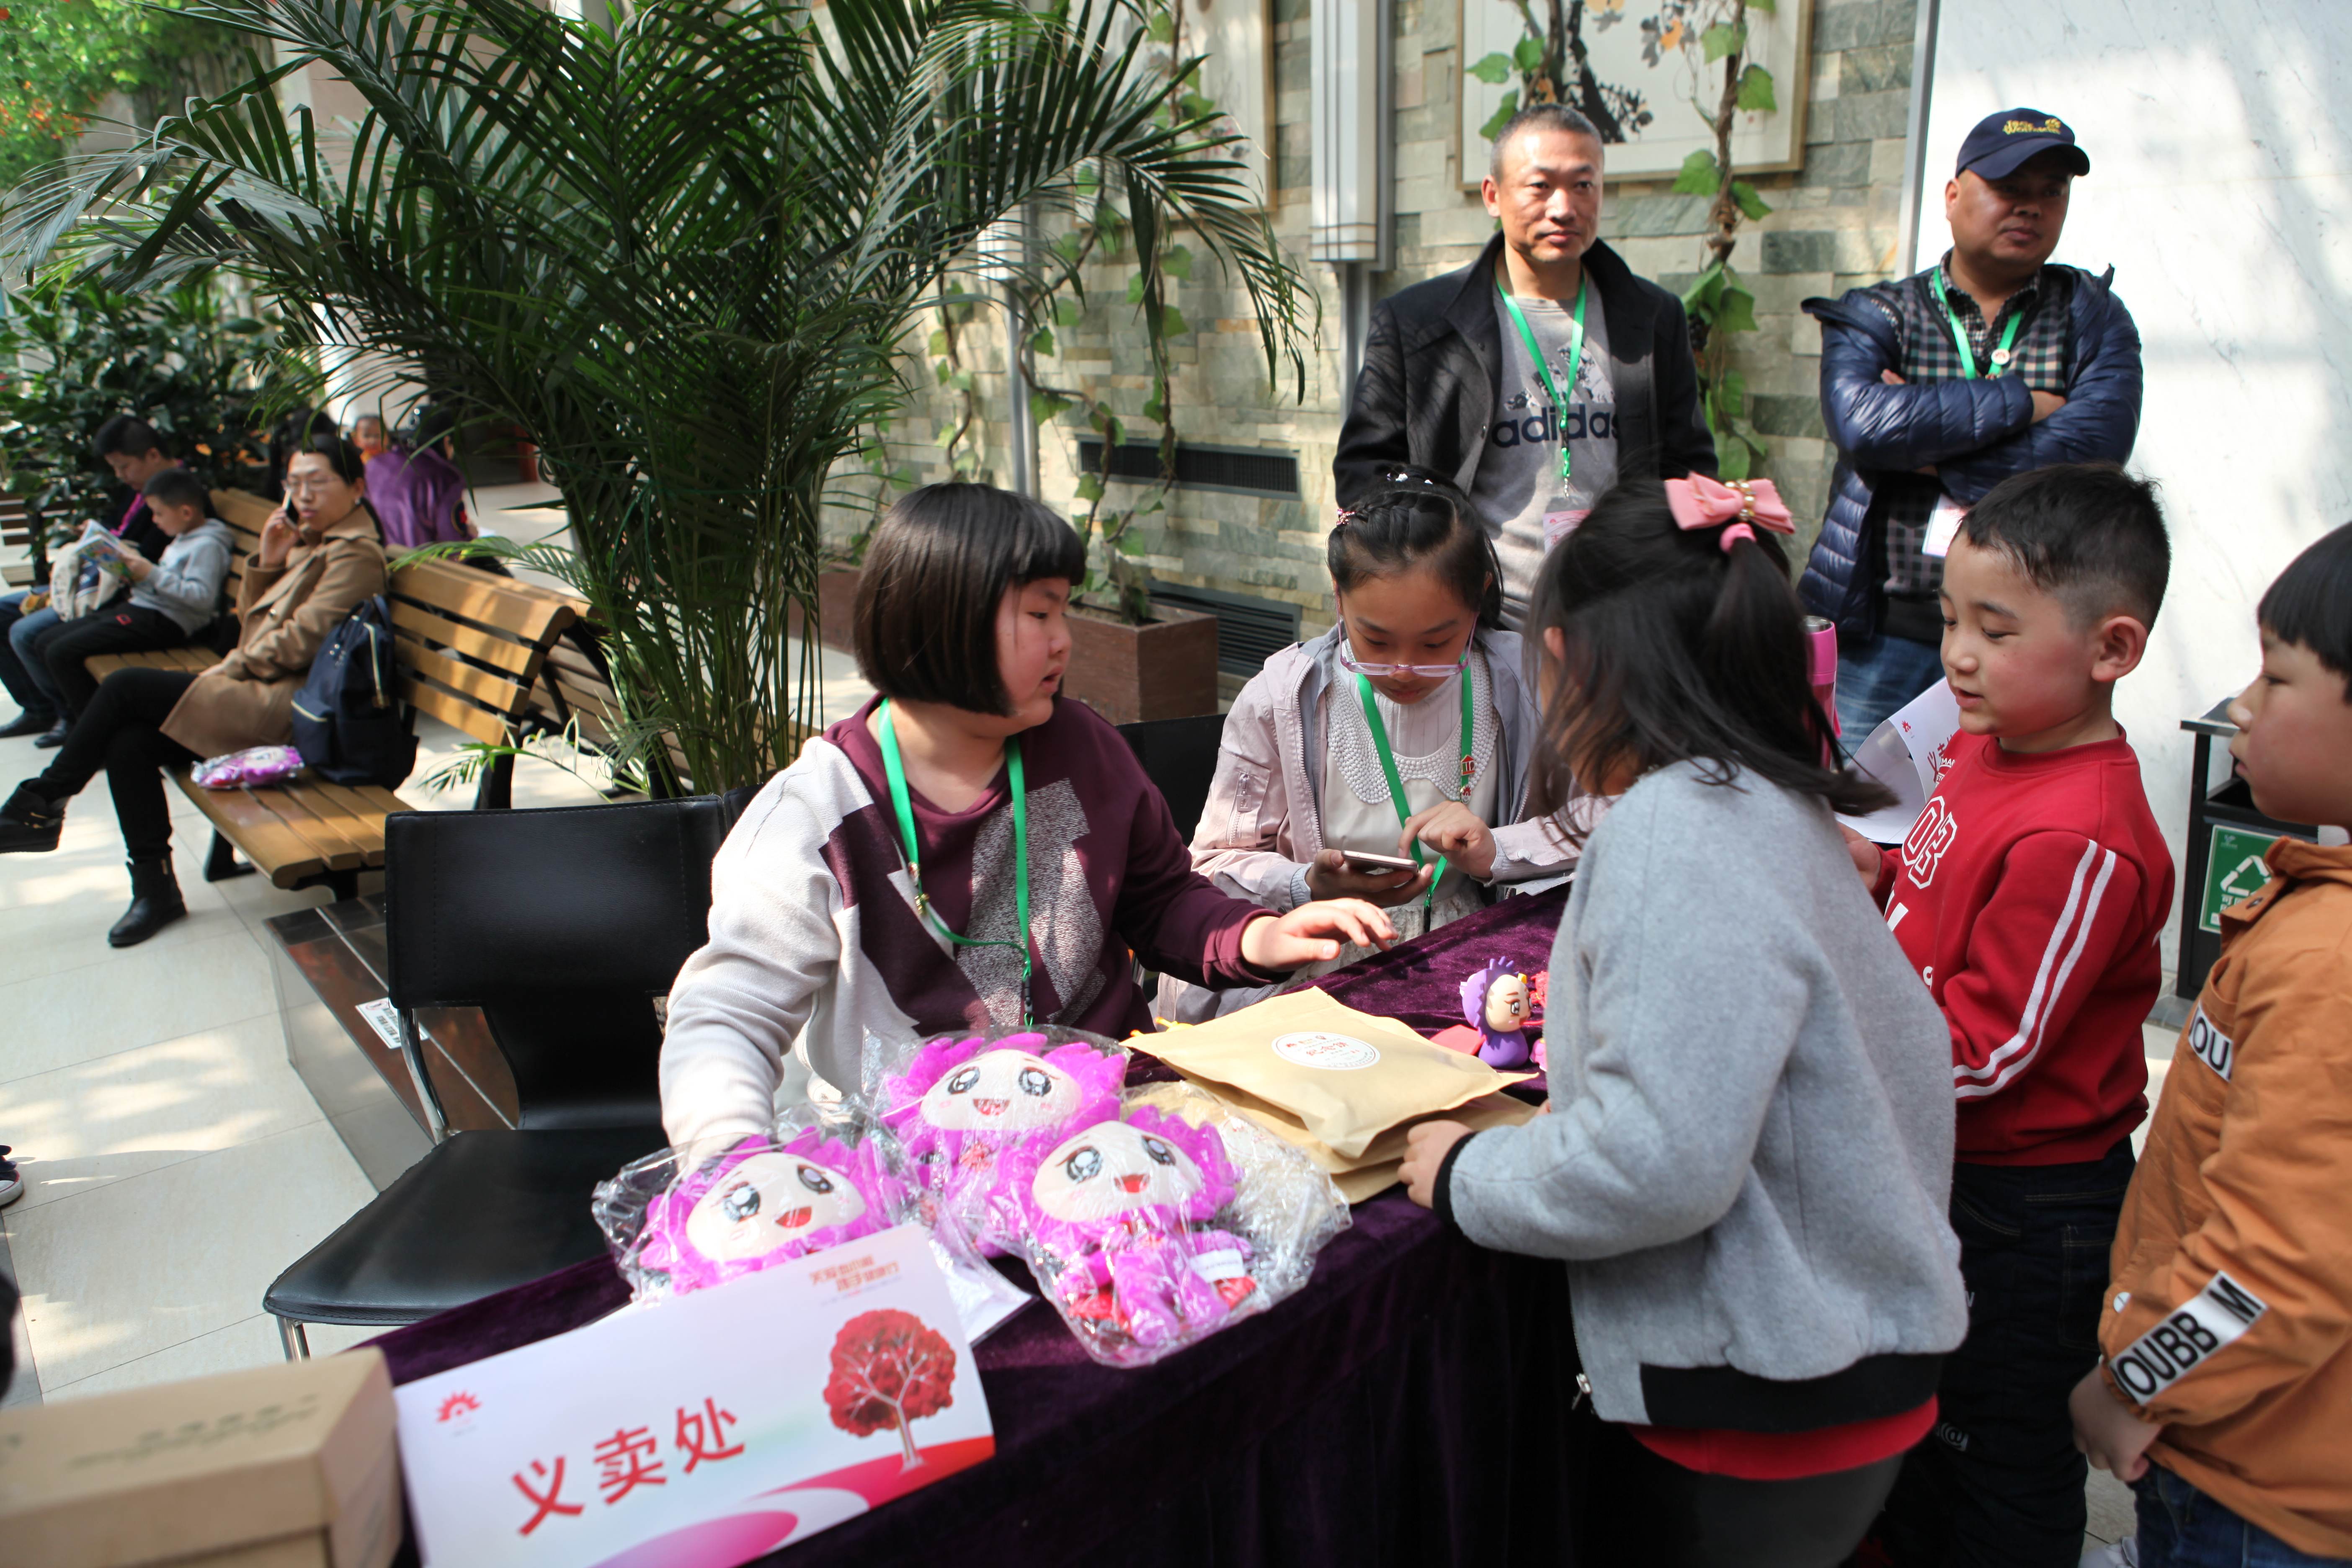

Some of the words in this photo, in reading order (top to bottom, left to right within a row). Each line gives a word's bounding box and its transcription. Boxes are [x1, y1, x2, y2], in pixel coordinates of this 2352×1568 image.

[2189, 1007, 2231, 1081] OU
[511, 1396, 745, 1537] 义卖处
